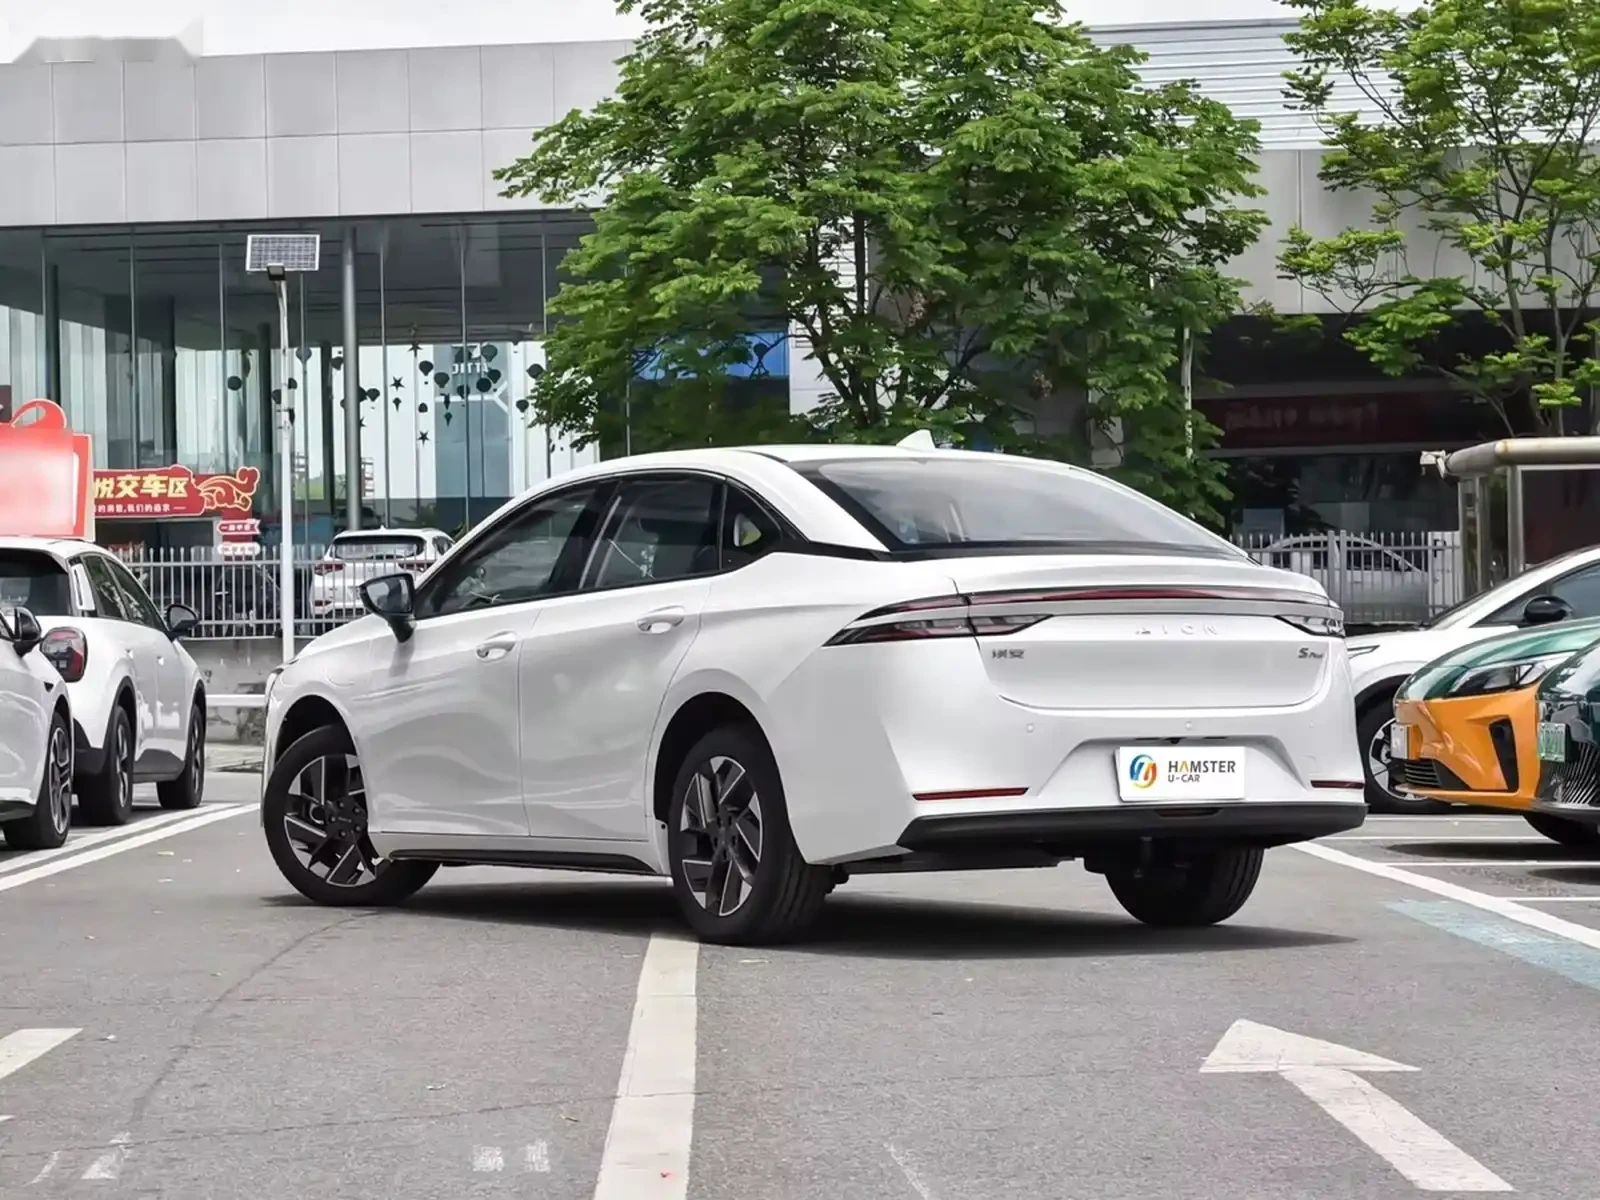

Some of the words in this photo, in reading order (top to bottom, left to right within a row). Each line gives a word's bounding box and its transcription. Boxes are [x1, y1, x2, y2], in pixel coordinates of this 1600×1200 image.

[1297, 648, 1309, 659] S
[1168, 760, 1236, 774] HAMSTER
[1168, 774, 1201, 783] U-CAR
